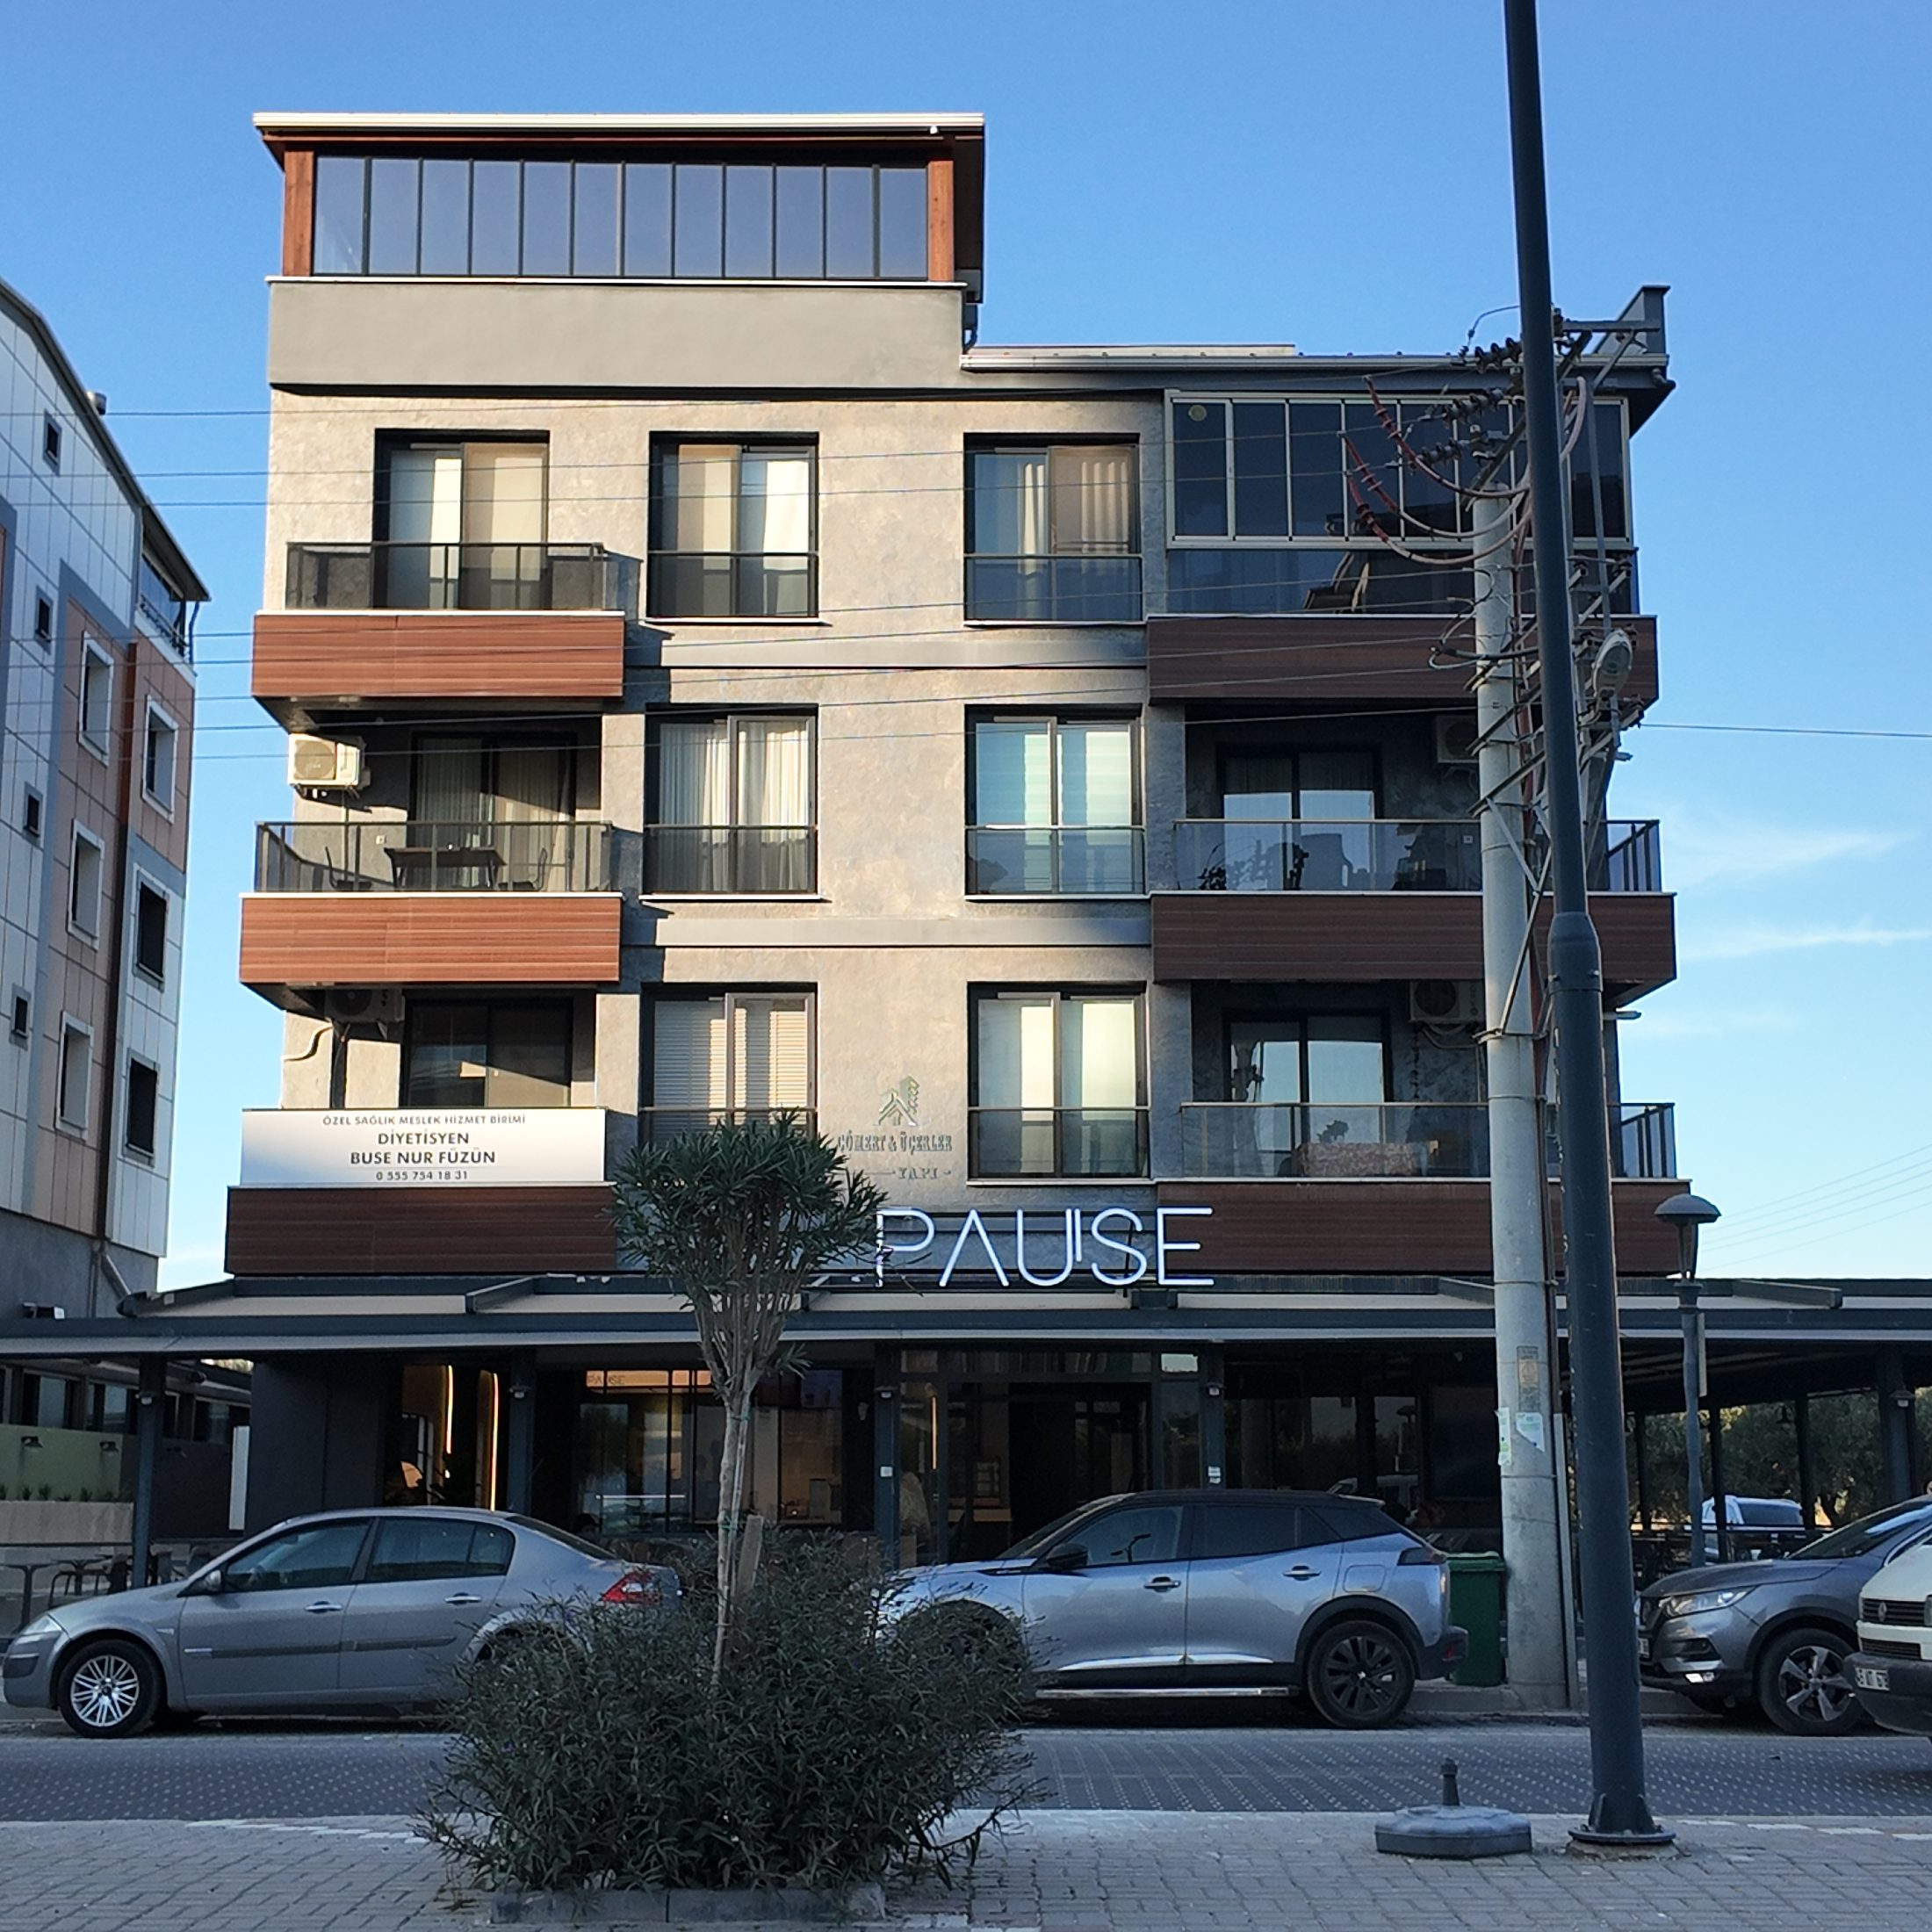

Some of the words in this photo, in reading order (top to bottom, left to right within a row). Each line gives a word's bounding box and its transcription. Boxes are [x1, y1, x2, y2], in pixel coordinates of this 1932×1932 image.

[322, 1114, 351, 1125] ÖZEL
[355, 1114, 395, 1125] SAĞLIK
[399, 1115, 441, 1125] MESLEK
[444, 1114, 486, 1125] HİZMET
[490, 1113, 525, 1124] BİRİMİ
[378, 1128, 469, 1144] DİYETİSYEN
[350, 1151, 392, 1164] BUSE
[397, 1151, 433, 1164] NUR
[438, 1146, 495, 1164] FÜZÜN
[376, 1171, 383, 1180] 0
[386, 1171, 408, 1180] 555
[412, 1171, 433, 1180] 754
[438, 1171, 451, 1180] 18
[455, 1170, 468, 1180] 31
[876, 1207, 1215, 1287] PAUSE
